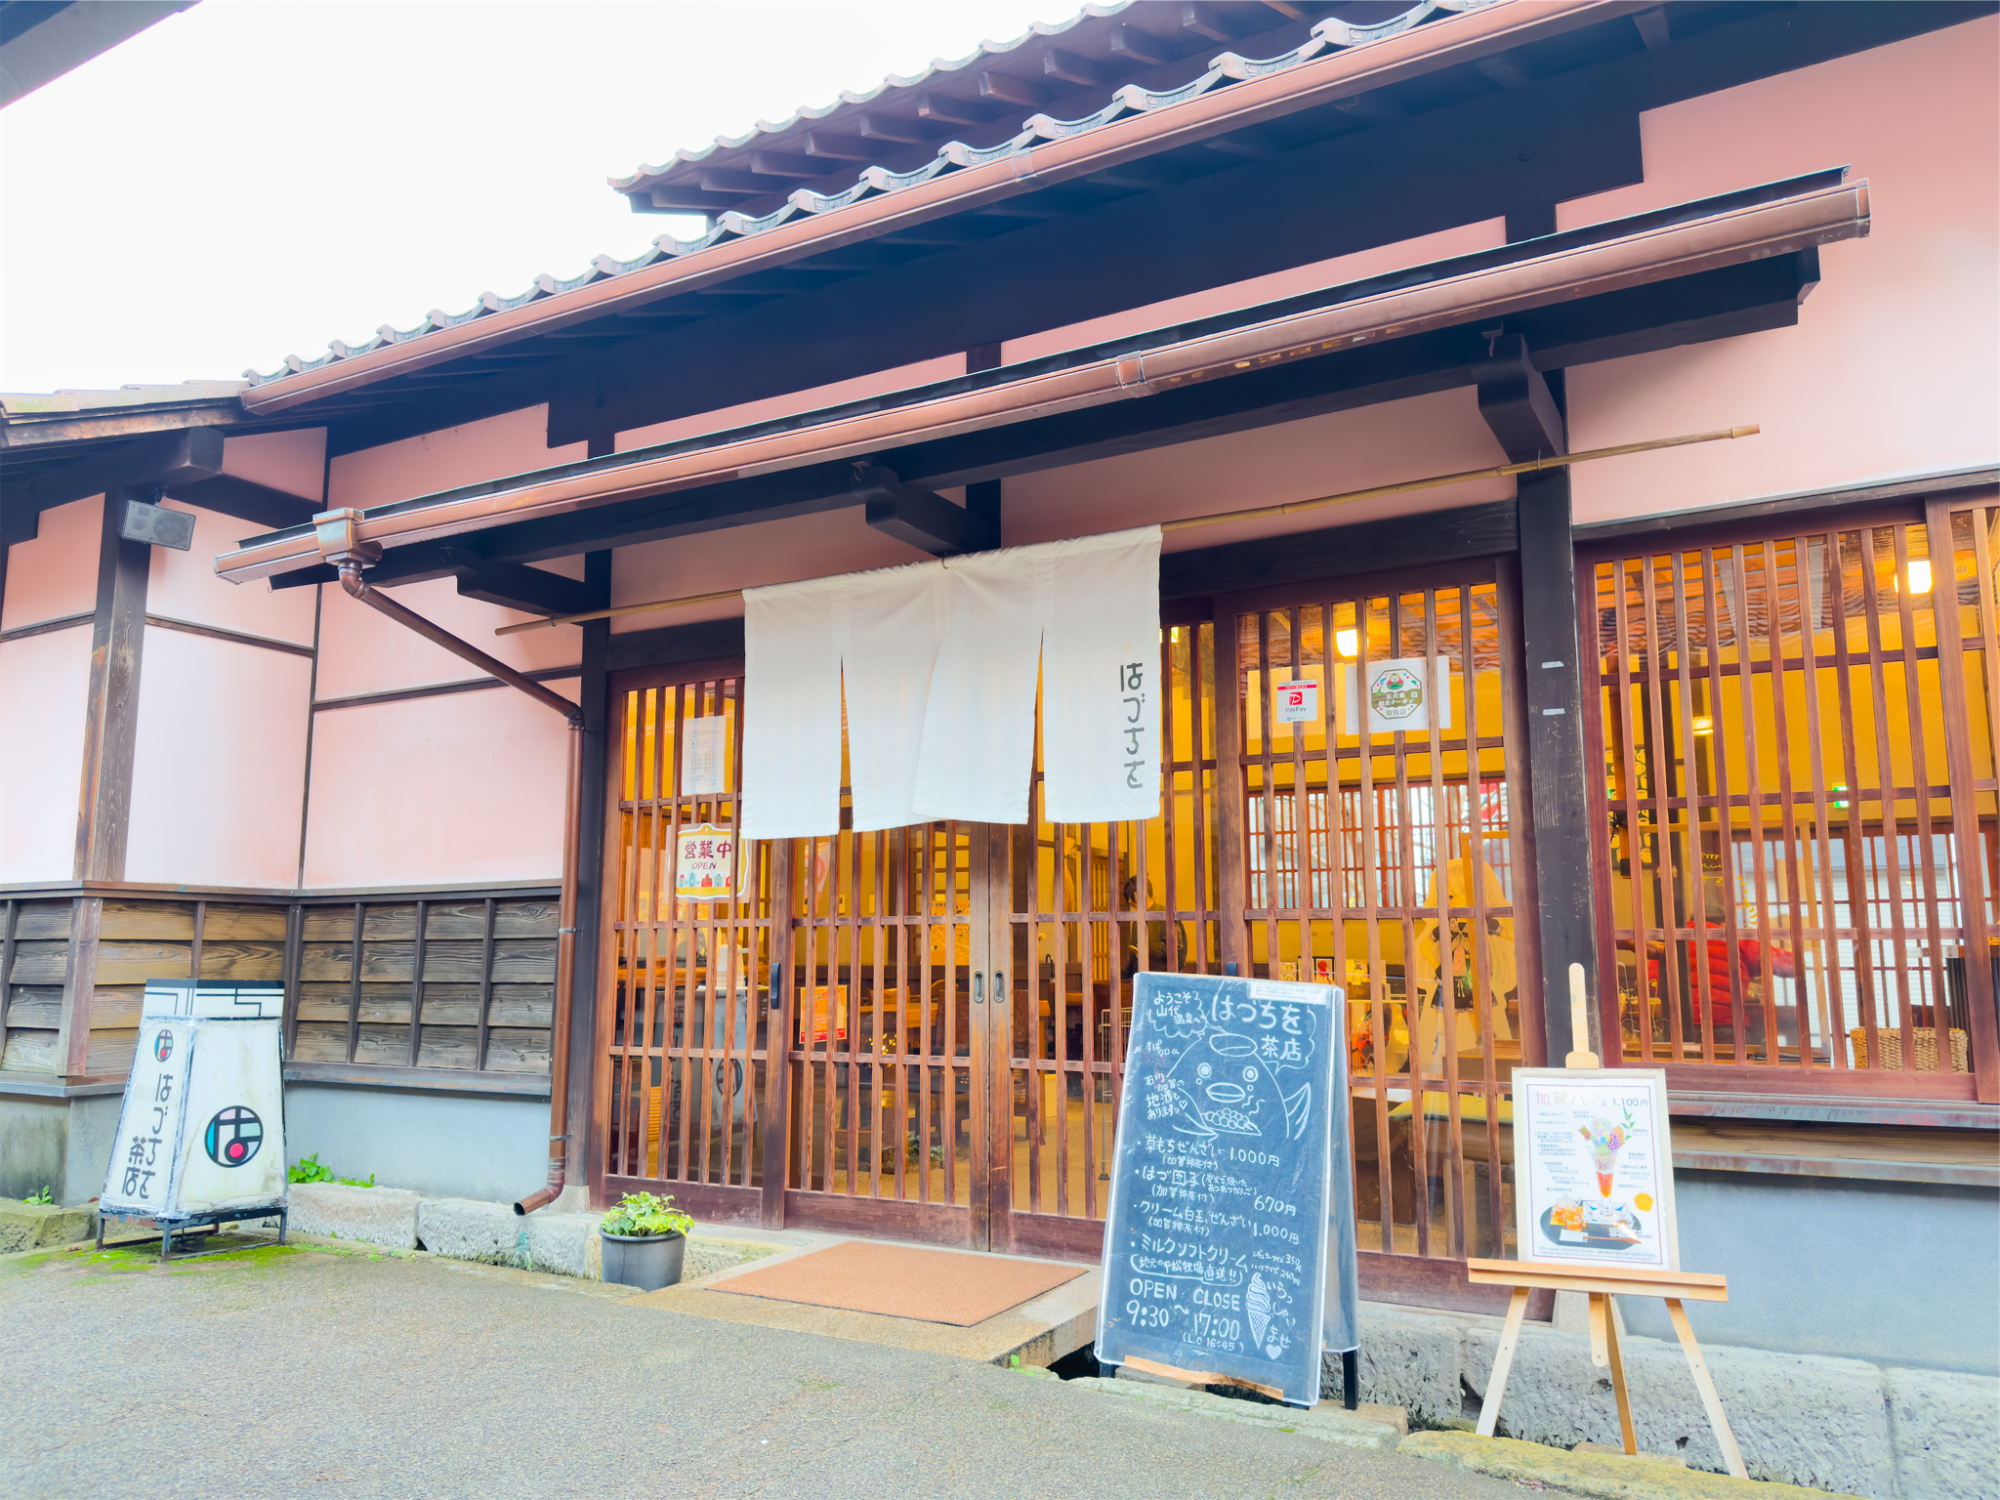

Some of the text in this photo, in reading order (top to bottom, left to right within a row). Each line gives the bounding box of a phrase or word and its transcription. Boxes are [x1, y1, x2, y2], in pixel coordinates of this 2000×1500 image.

[1120, 662, 1146, 789] はづちを
[684, 839, 732, 860] 営業中
[691, 862, 717, 870] OPEN
[1154, 990, 1192, 1005] ようこそ
[1156, 1004, 1180, 1017] 山代
[1212, 994, 1303, 1035] はづちを
[1261, 1035, 1302, 1061] 茶店
[1145, 1090, 1180, 1107] 地酒も
[1612, 1098, 1649, 1108] 1,100円
[139, 1072, 174, 1199] はづちを
[121, 1136, 147, 1196] 茶店
[1254, 1194, 1297, 1216] 670円
[1141, 1233, 1248, 1273] ミルクソフトクリーム
[1129, 1278, 1241, 1312] OPEN CLOSE
[1126, 1299, 1169, 1328] 9:30
[1193, 1312, 1241, 1341] 17:00
